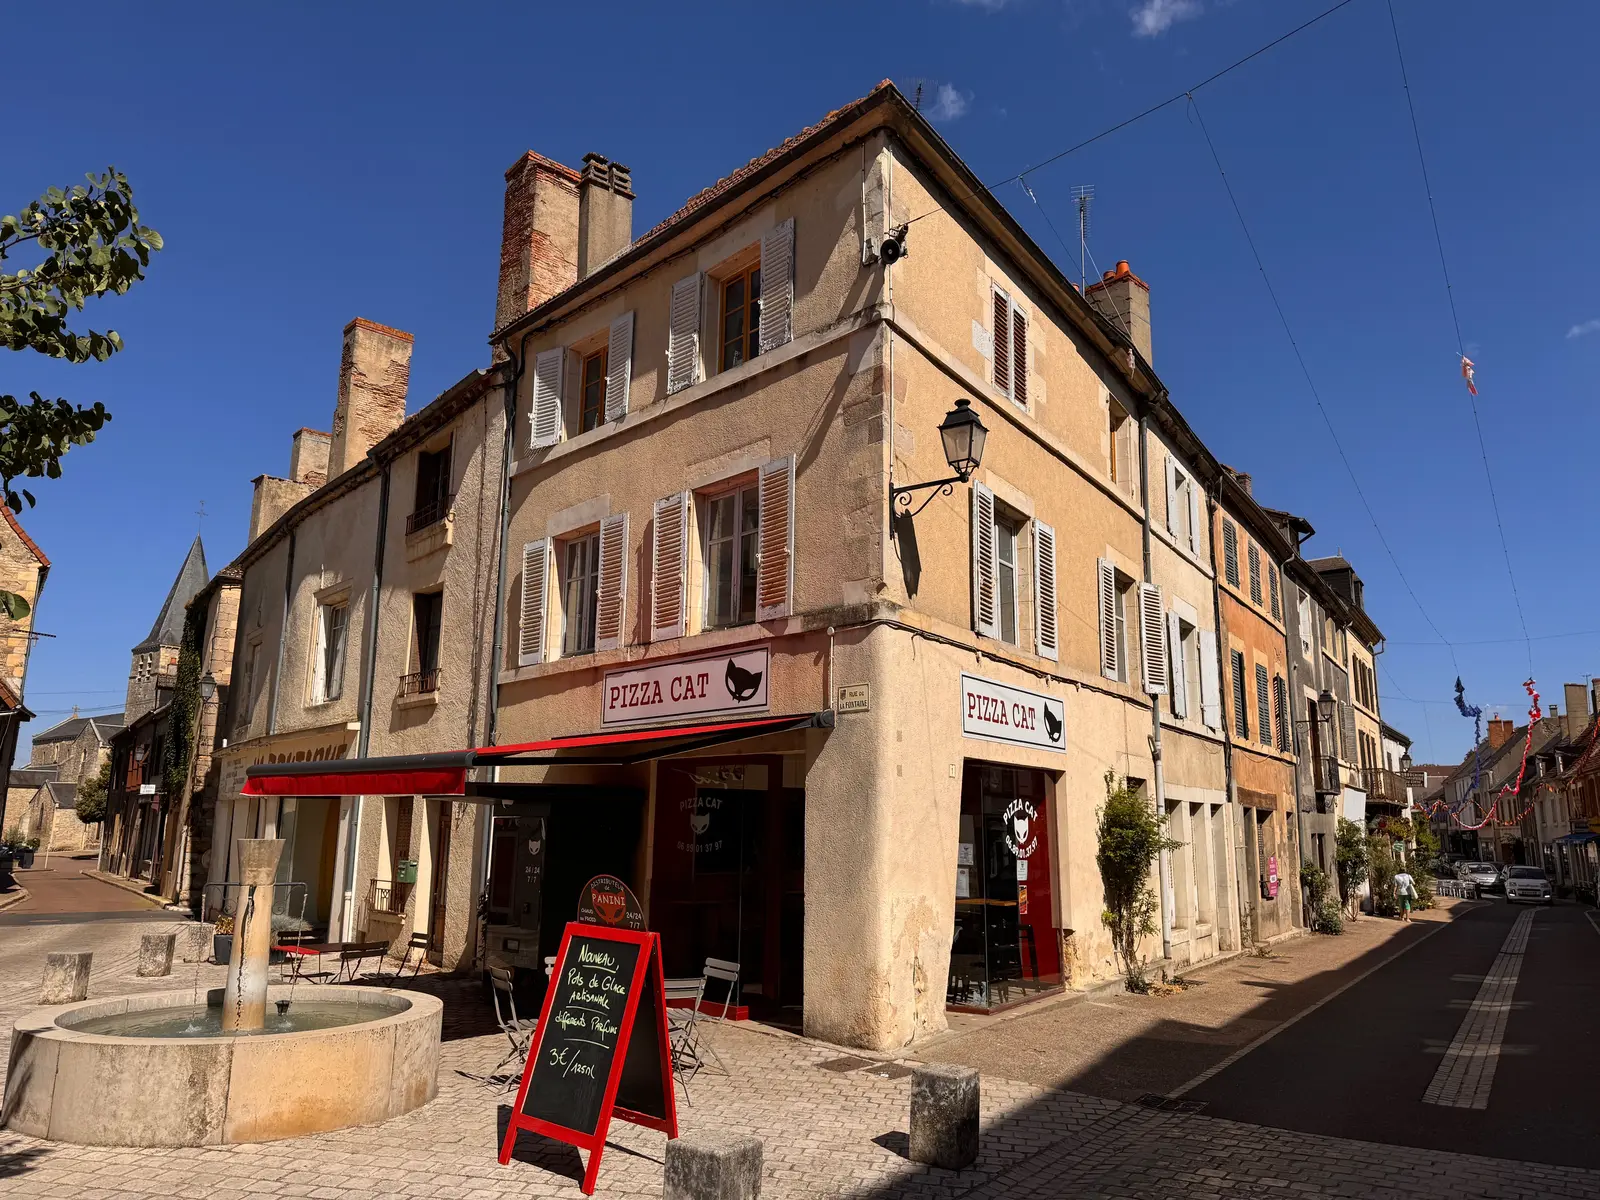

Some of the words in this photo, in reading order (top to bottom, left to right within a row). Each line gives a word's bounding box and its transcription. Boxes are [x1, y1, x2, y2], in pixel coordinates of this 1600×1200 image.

[609, 680, 663, 709] PIZZA
[670, 673, 709, 702] CAT
[845, 700, 867, 708] FONTAINE
[967, 692, 1009, 725] PIZZA
[1012, 703, 1036, 730] CAT
[679, 797, 704, 812] PIZZA
[705, 796, 723, 810] CAT
[1002, 798, 1024, 825] PIZZA
[1024, 801, 1038, 822] CAT
[590, 878, 624, 892] DISTRIBUTEUR
[591, 893, 626, 911] PANINI
[626, 912, 642, 921] 24/24
[629, 921, 640, 929] 7/7
[567, 967, 584, 986] Pots
